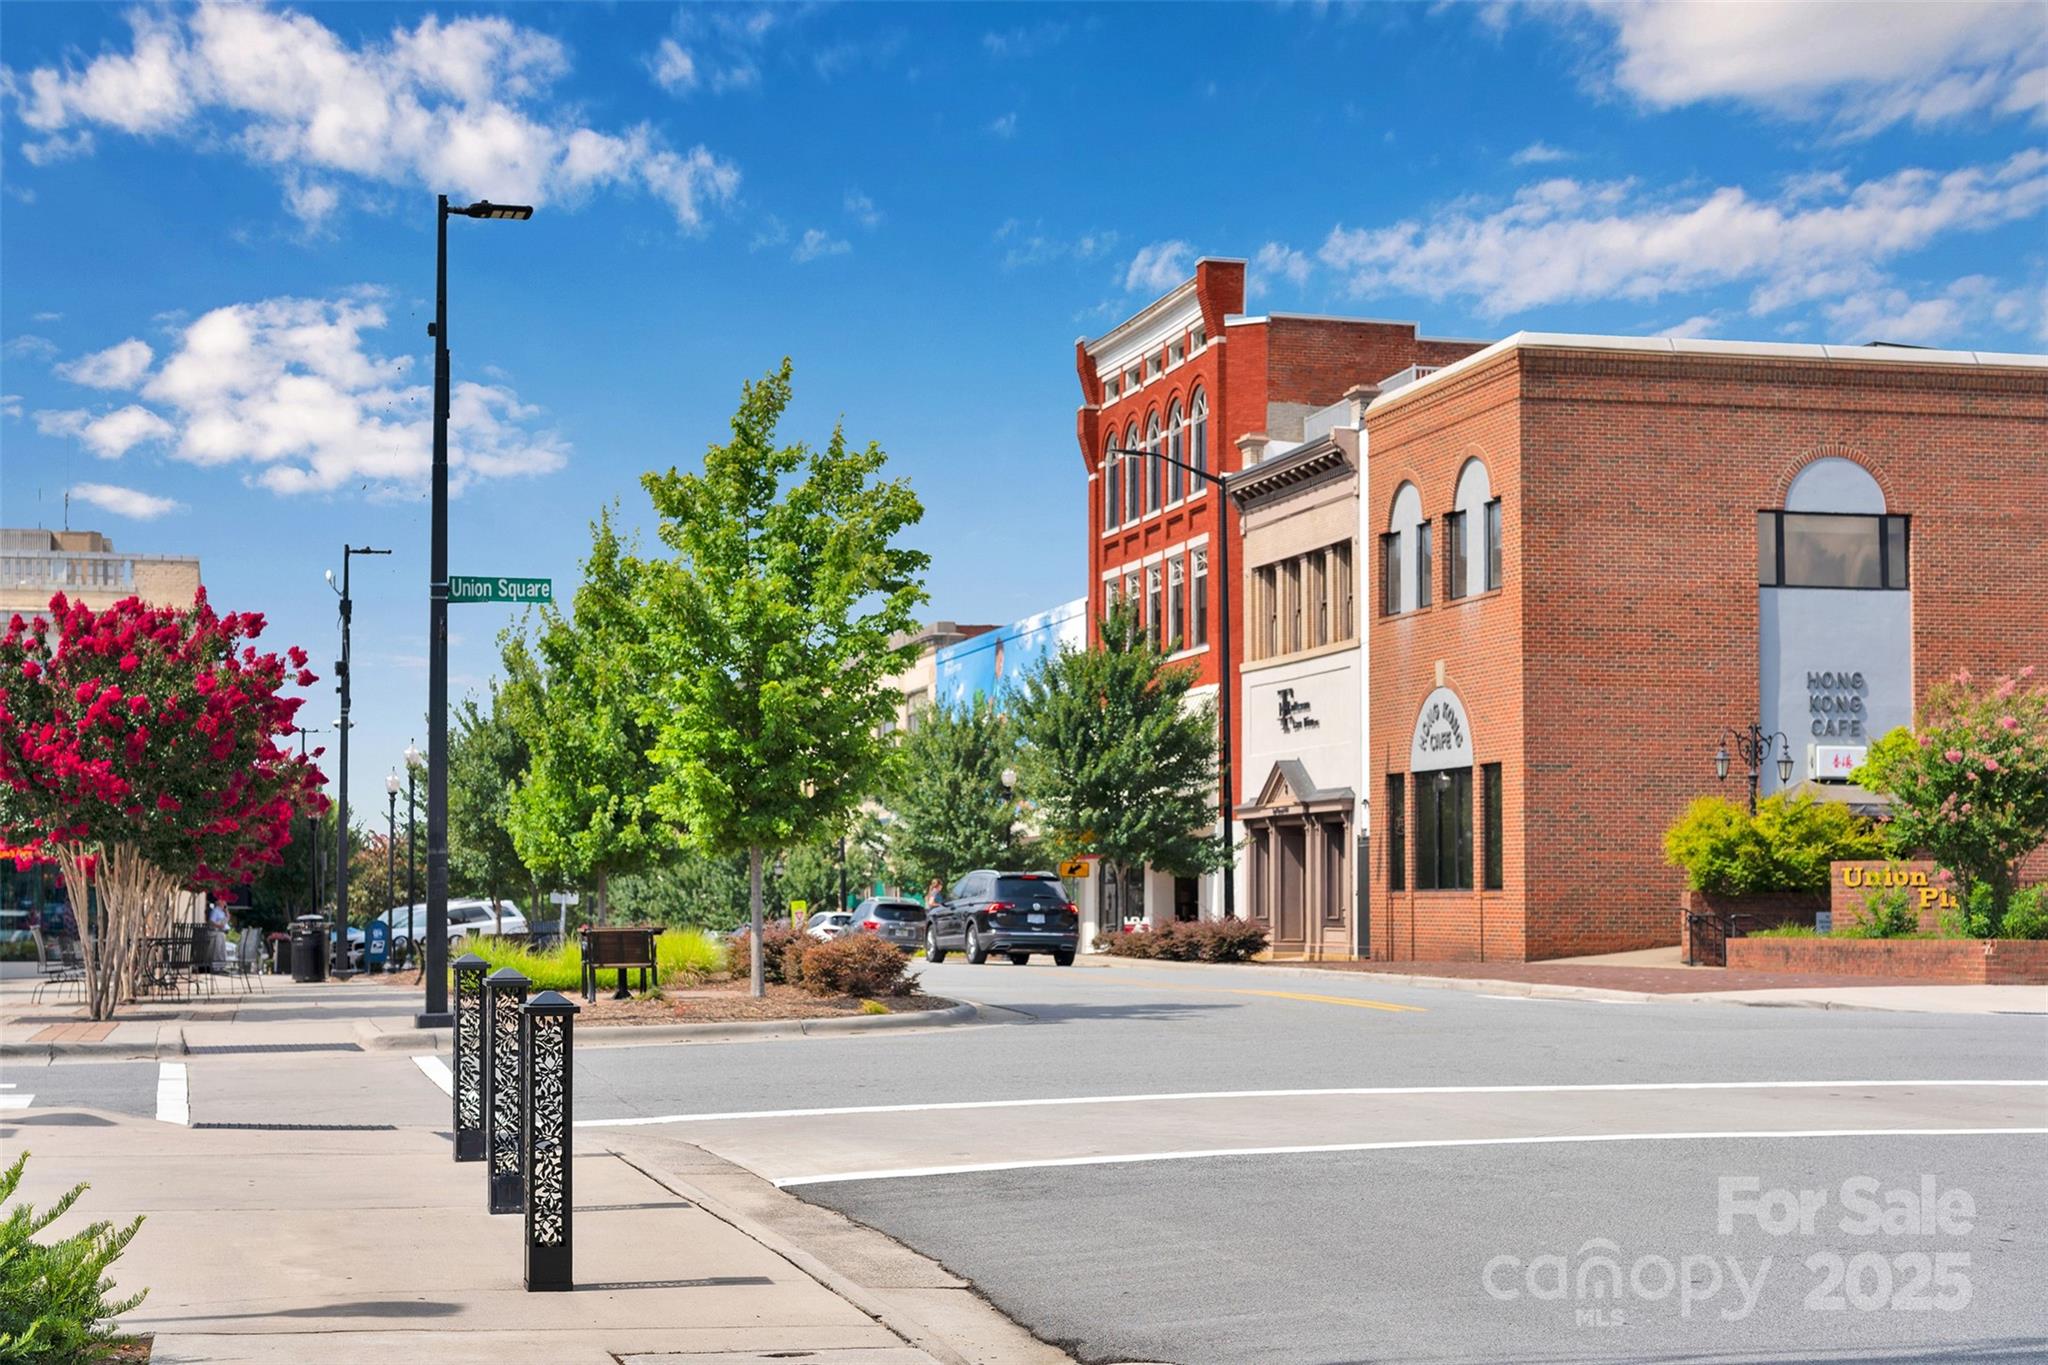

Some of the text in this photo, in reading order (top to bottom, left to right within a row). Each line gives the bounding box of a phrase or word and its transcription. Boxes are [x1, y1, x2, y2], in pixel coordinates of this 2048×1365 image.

[451, 578, 550, 601] Union Square
[1806, 671, 1864, 690] HONG
[1808, 695, 1863, 713] KONG
[1419, 701, 1464, 752] HONG KONG
[1810, 719, 1861, 737] CAFE
[1430, 731, 1452, 752] CAFE
[1842, 866, 1929, 888] Union
